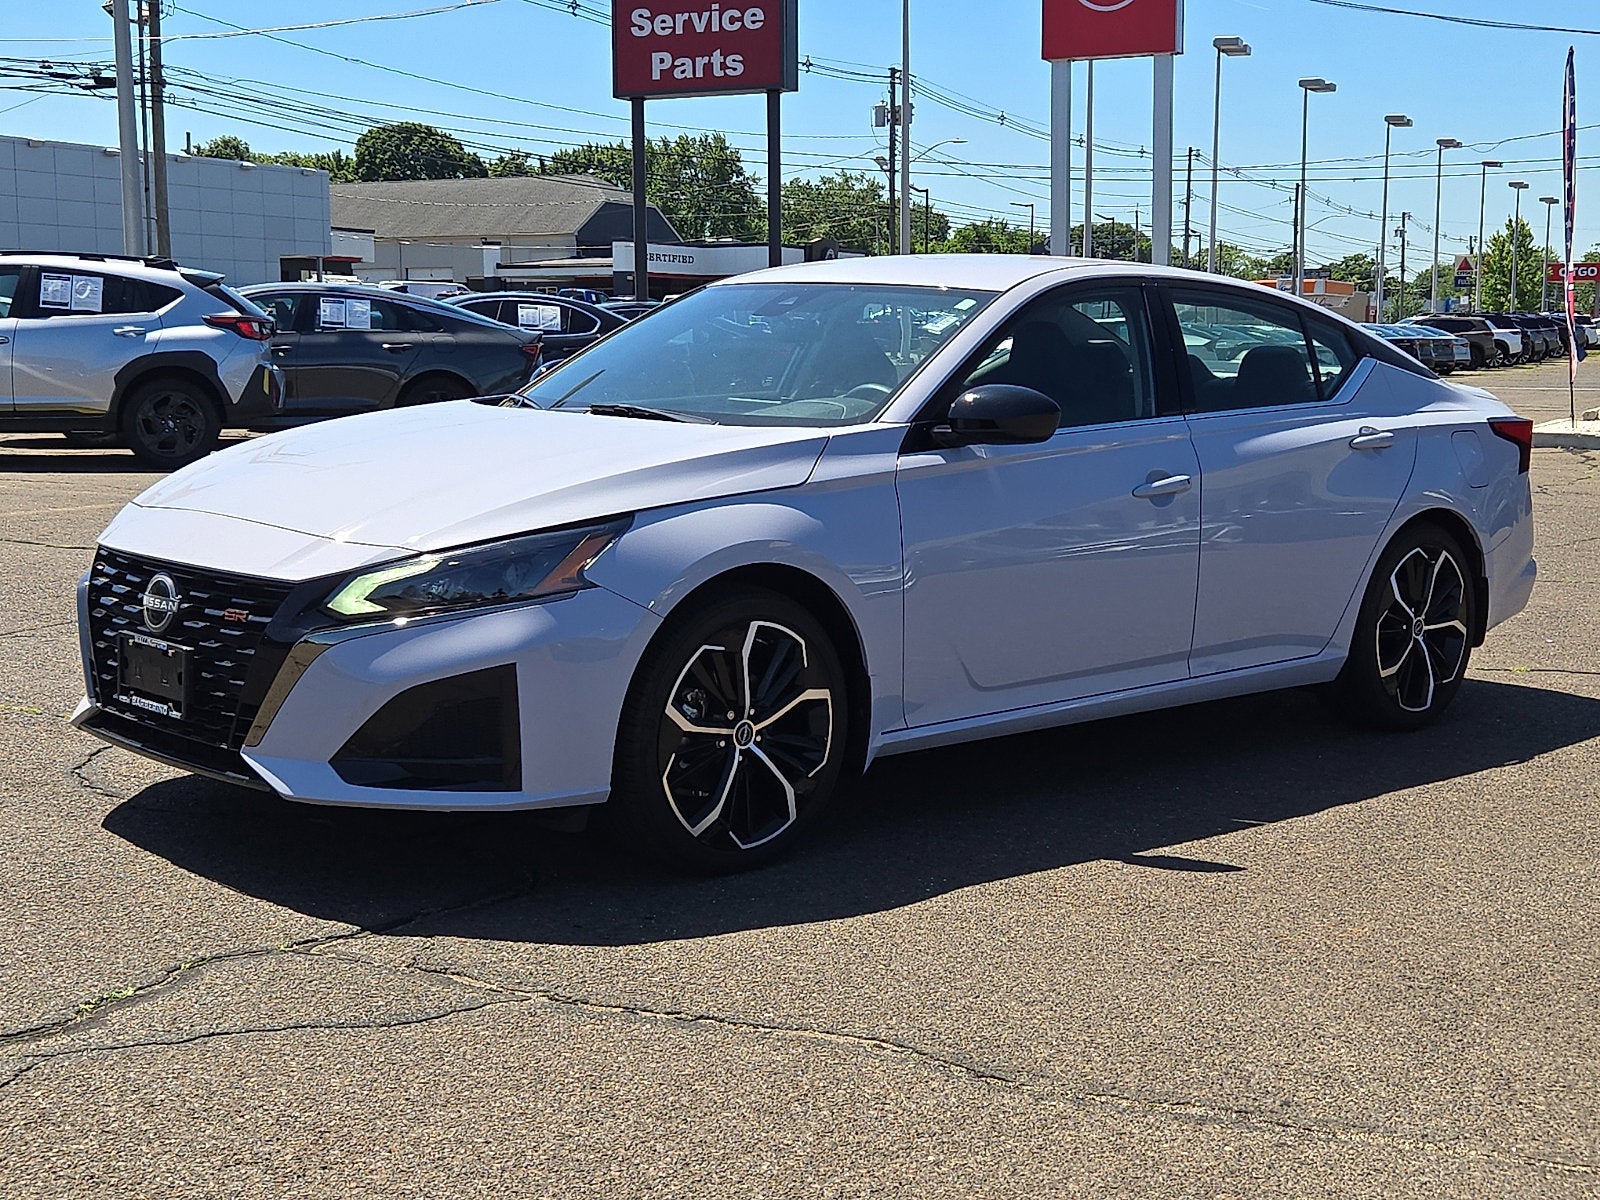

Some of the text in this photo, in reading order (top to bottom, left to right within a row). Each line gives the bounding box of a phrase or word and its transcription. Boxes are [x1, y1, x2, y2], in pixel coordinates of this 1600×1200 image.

[630, 3, 765, 37] Service
[651, 49, 745, 81] Parts
[1559, 266, 1598, 277] CTGO
[224, 608, 249, 622] SR
